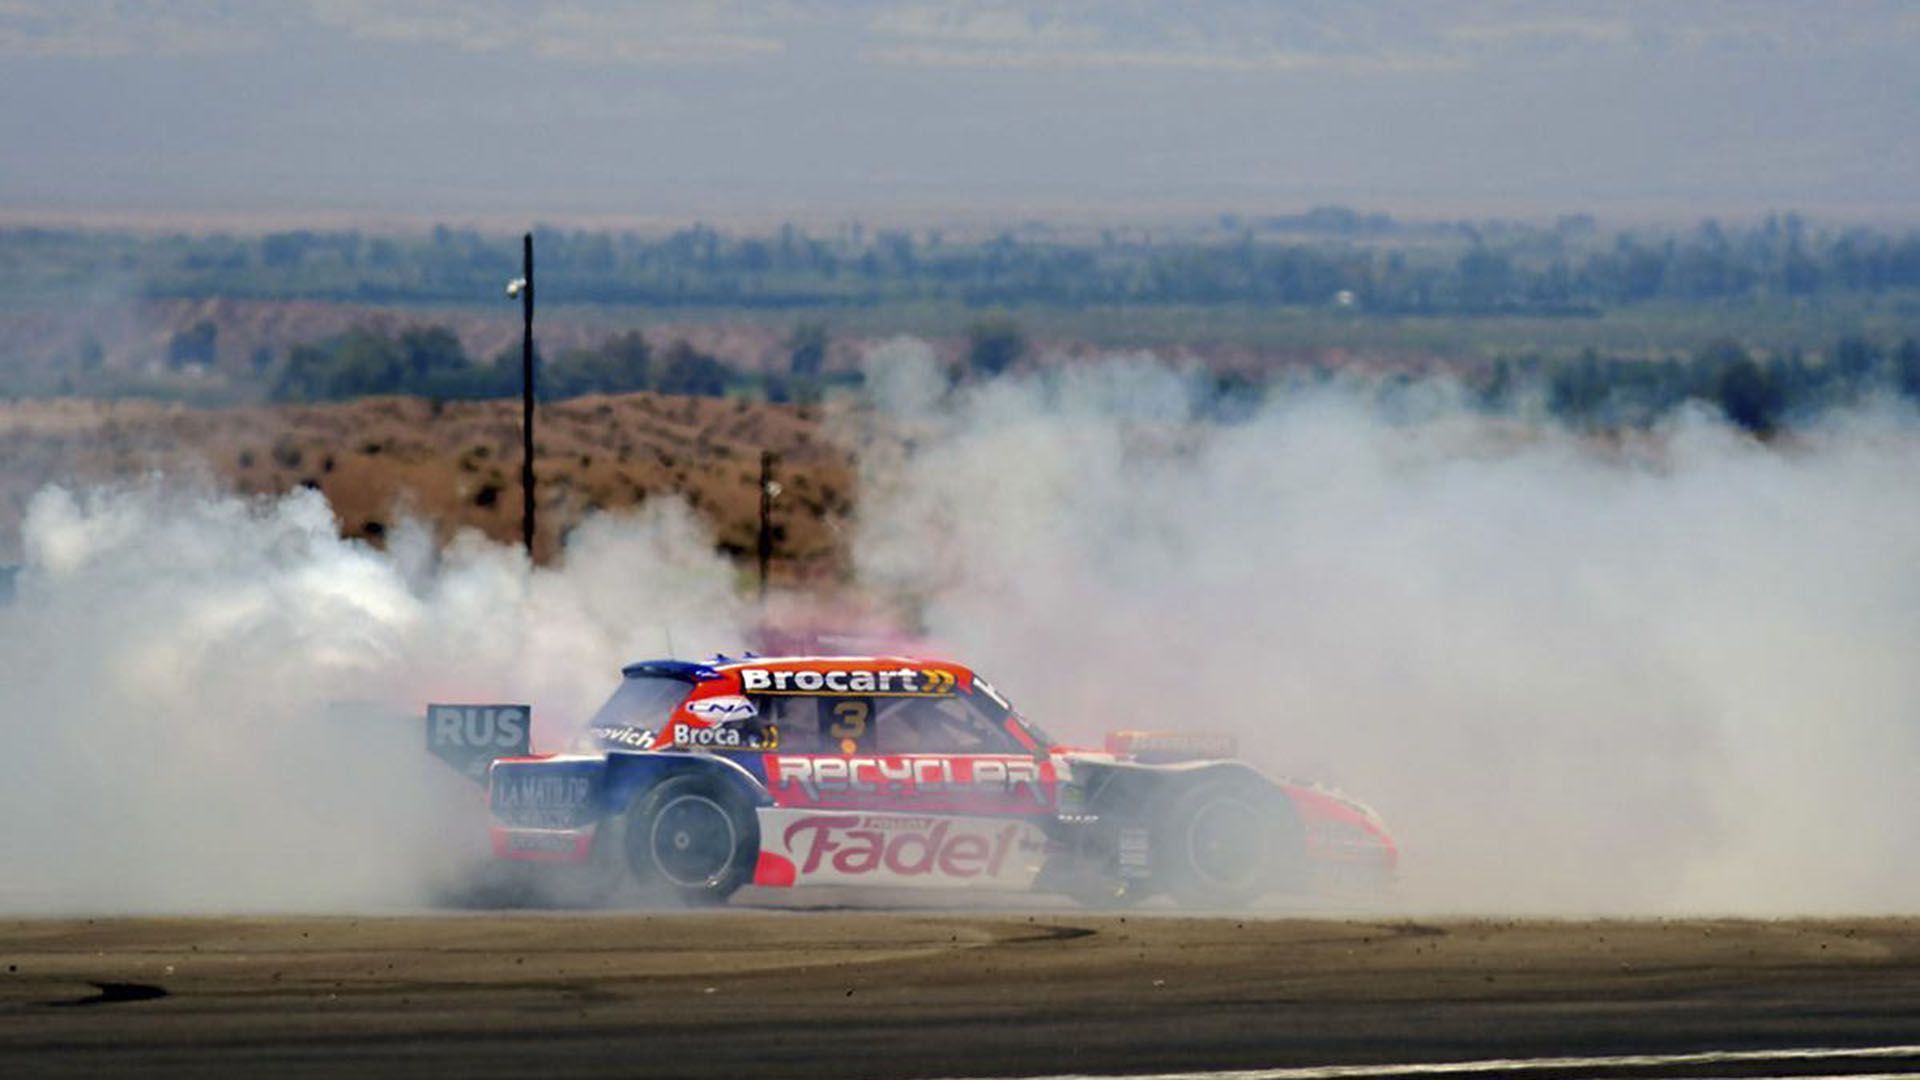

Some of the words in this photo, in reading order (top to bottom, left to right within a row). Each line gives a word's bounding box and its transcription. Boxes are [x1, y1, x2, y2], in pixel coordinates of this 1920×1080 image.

[741, 669, 918, 691] Brocart
[436, 709, 523, 747] RUS
[593, 726, 656, 748] ovich
[830, 701, 868, 739] 3
[777, 756, 1048, 804] RECYCLER
[783, 815, 1018, 878] Fadel
